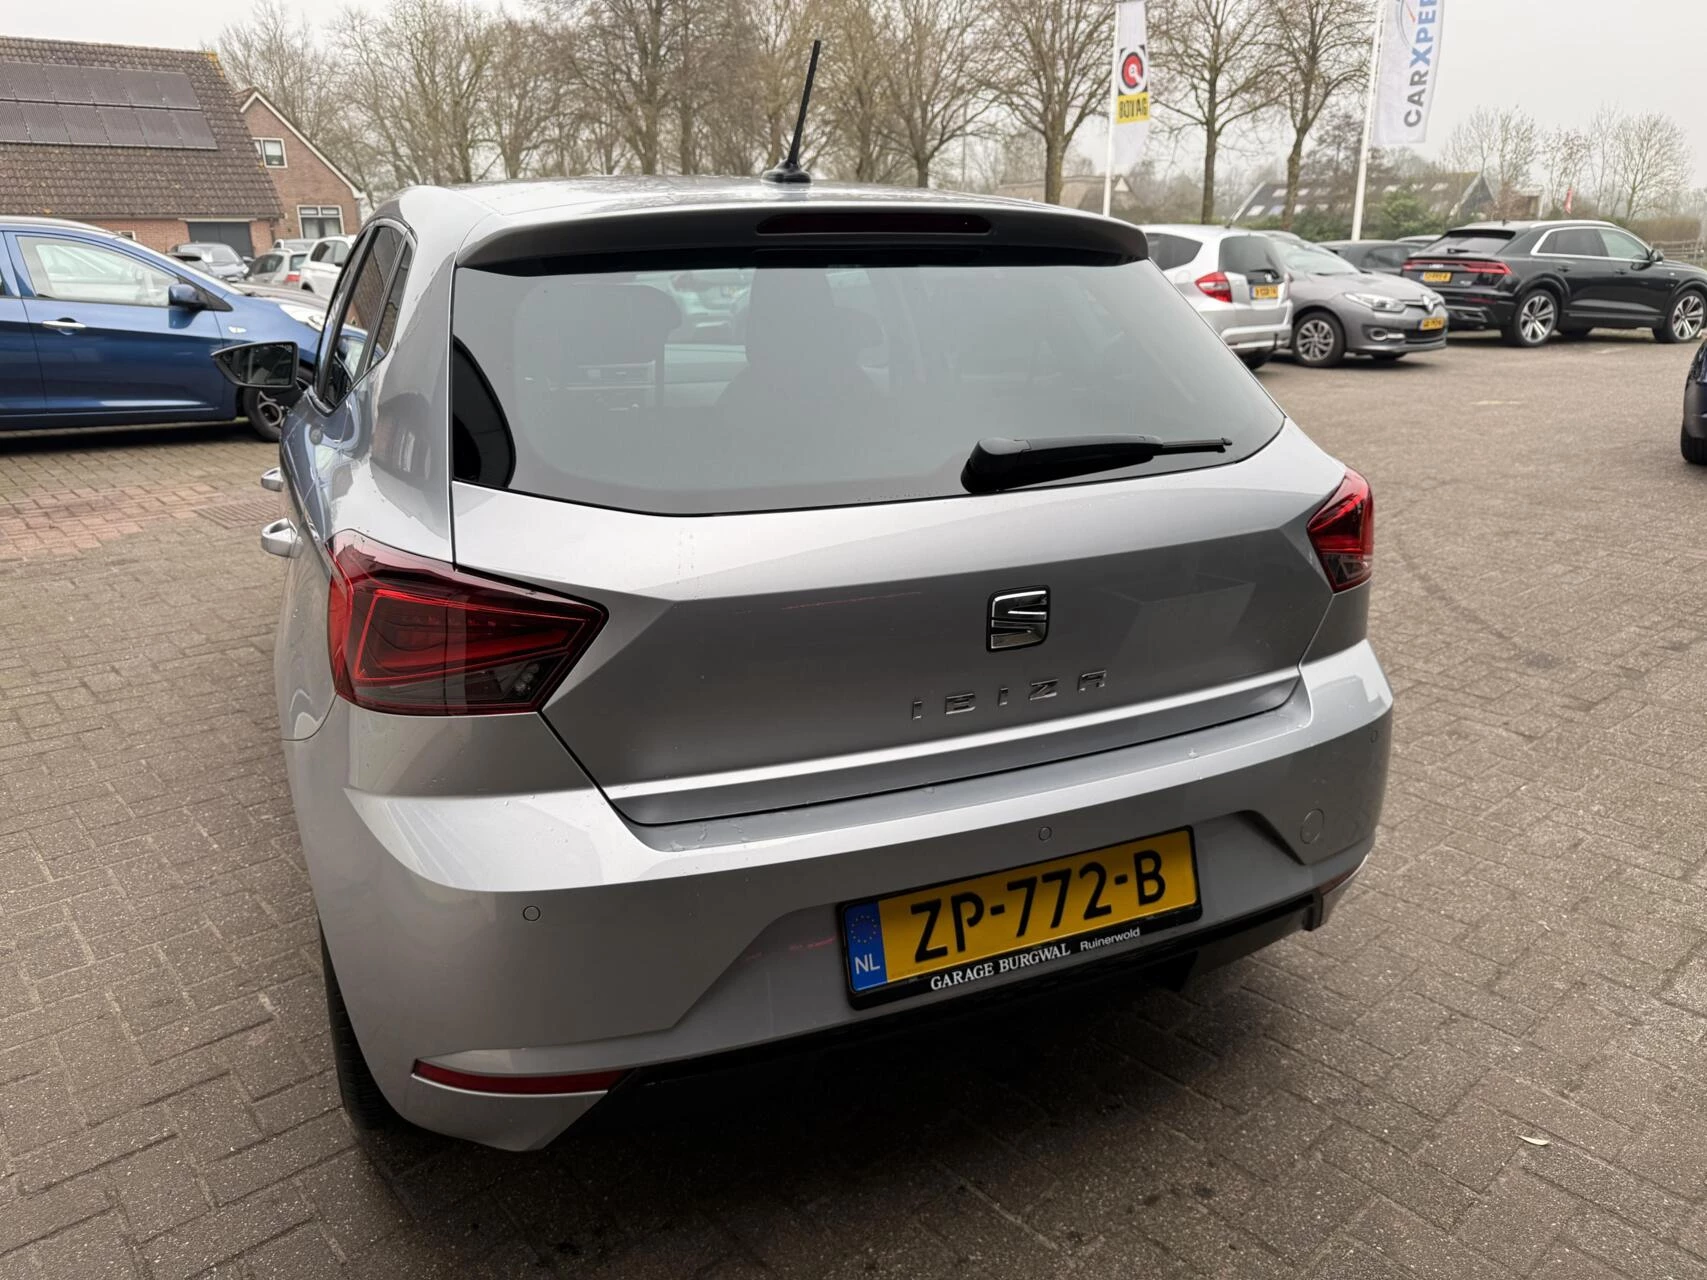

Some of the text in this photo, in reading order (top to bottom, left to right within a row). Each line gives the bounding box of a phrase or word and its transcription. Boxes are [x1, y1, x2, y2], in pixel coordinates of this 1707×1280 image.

[911, 669, 1107, 720] IBIZA
[910, 849, 1167, 963] ZP-772-B
[854, 953, 880, 975] NL
[930, 927, 1141, 991] GARAGE BURGWAL Ruinerwold
